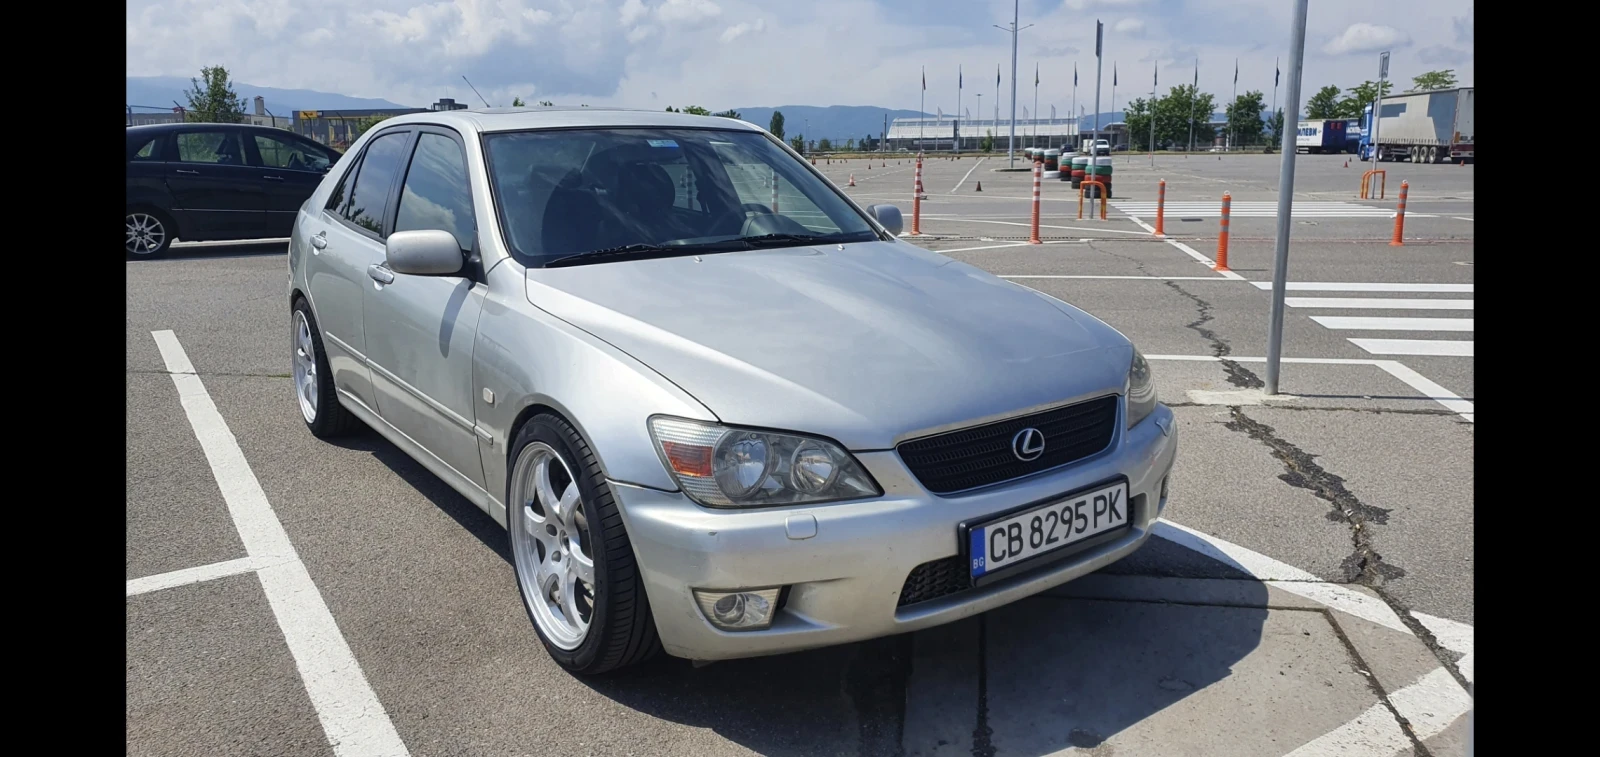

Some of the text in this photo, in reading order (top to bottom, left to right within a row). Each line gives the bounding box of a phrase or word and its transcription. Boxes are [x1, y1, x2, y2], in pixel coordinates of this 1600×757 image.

[990, 488, 1122, 563] CB 8295 PK
[972, 556, 984, 569] BG
